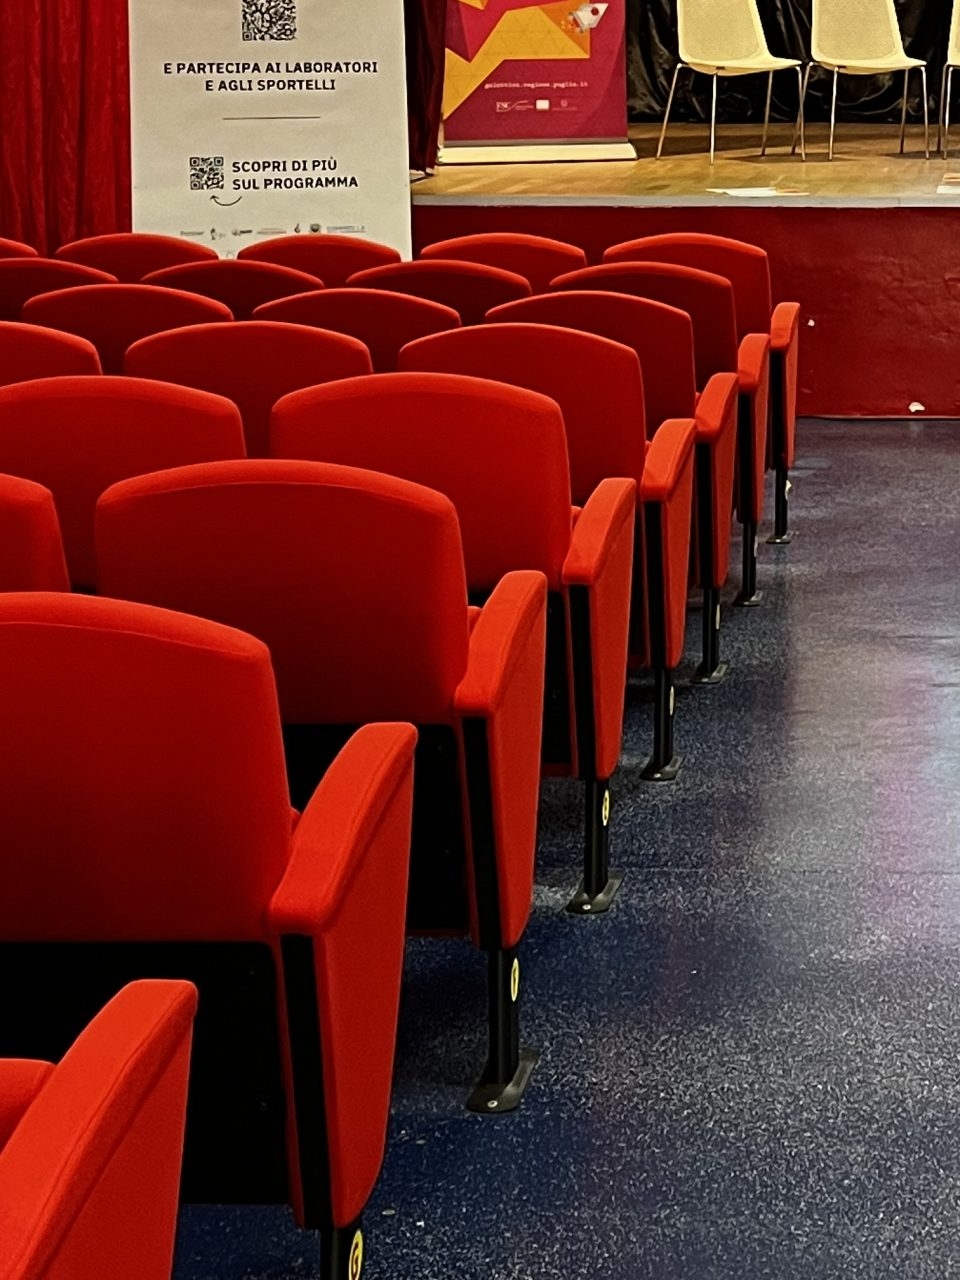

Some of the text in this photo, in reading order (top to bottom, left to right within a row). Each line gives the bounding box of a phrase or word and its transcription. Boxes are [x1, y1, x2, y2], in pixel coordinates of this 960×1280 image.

[163, 61, 379, 75] E PARTECIPA AI LABORATORI
[205, 79, 337, 92] E AGLI SPORTELLI
[231, 156, 338, 173] SCOPRI DI PIÙ
[232, 176, 359, 191] SUL PROGRAMMA
